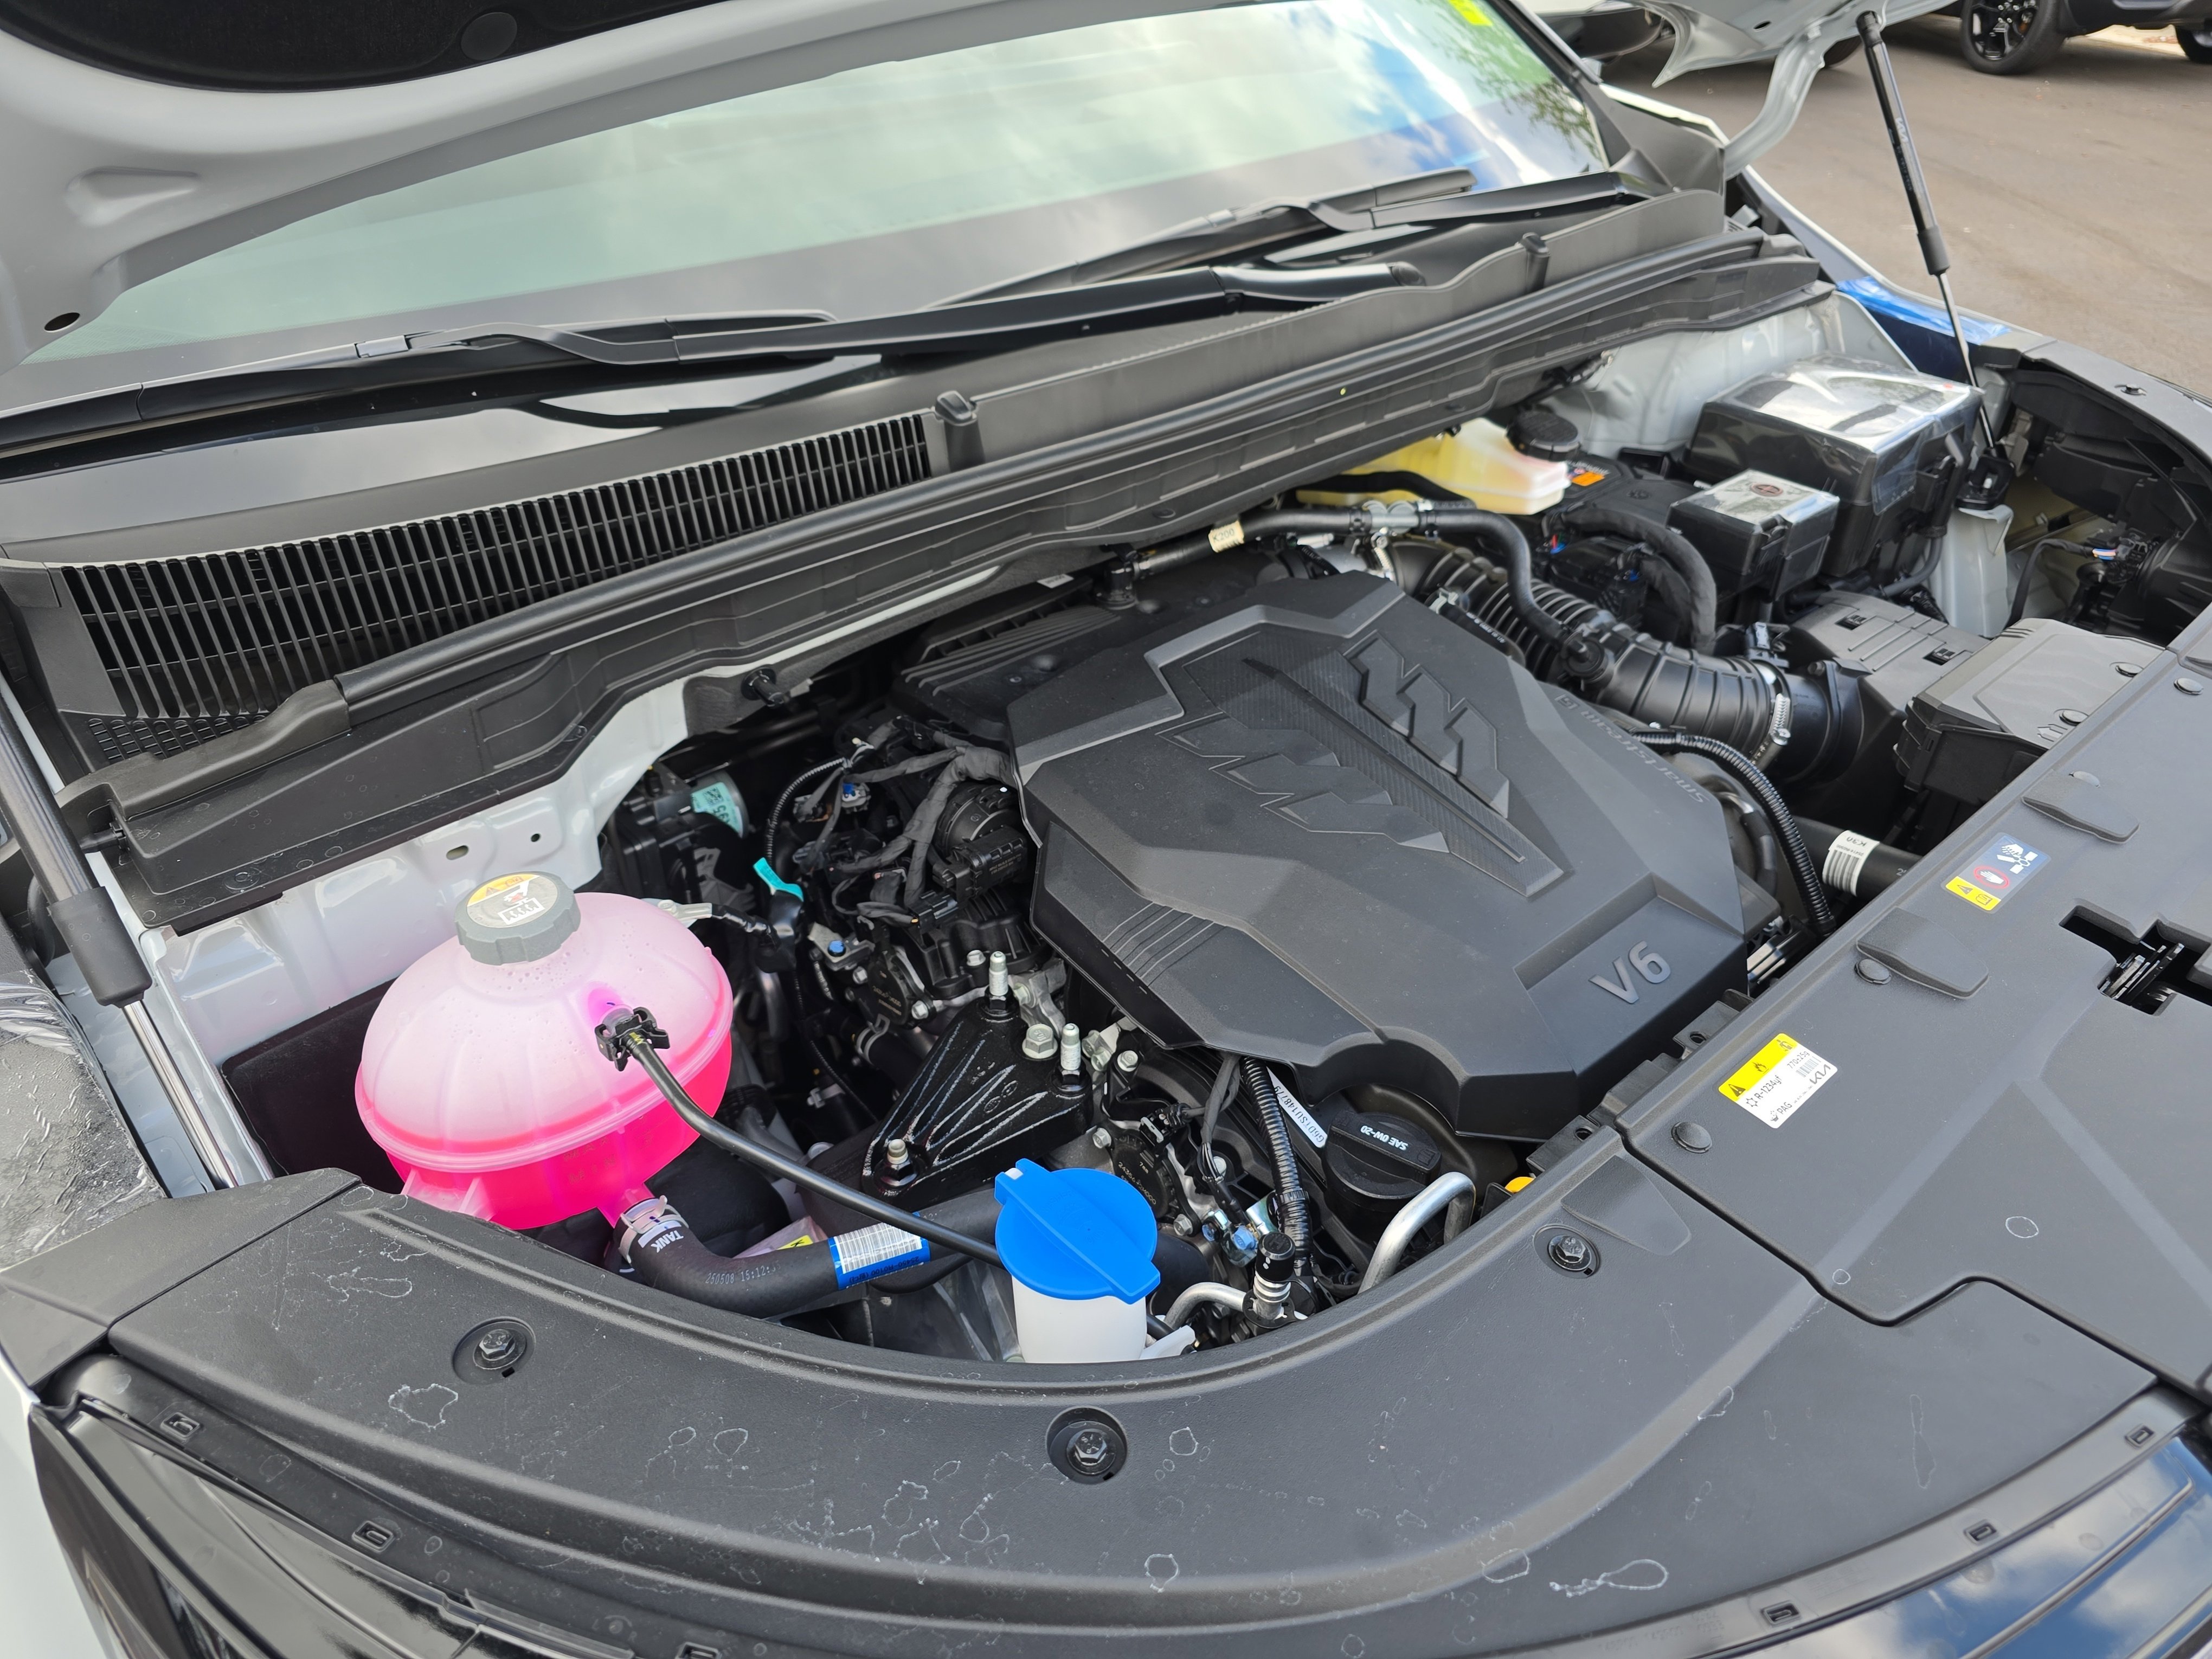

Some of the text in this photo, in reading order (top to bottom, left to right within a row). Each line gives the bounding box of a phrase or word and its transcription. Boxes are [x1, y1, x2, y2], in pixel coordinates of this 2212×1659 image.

[1212, 528, 1234, 543] K200
[1580, 710, 1709, 803] Smartstream
[1847, 836, 1868, 847] K30
[1588, 940, 1671, 1004] V6
[1809, 1064, 1831, 1084] KIA
[1754, 1075, 1783, 1099] R-1234yf
[1777, 1102, 1793, 1115] PAG
[1360, 1126, 1409, 1150] SAE 0W-20
[651, 1230, 684, 1253] TANK
[705, 1272, 735, 1285] 250508
